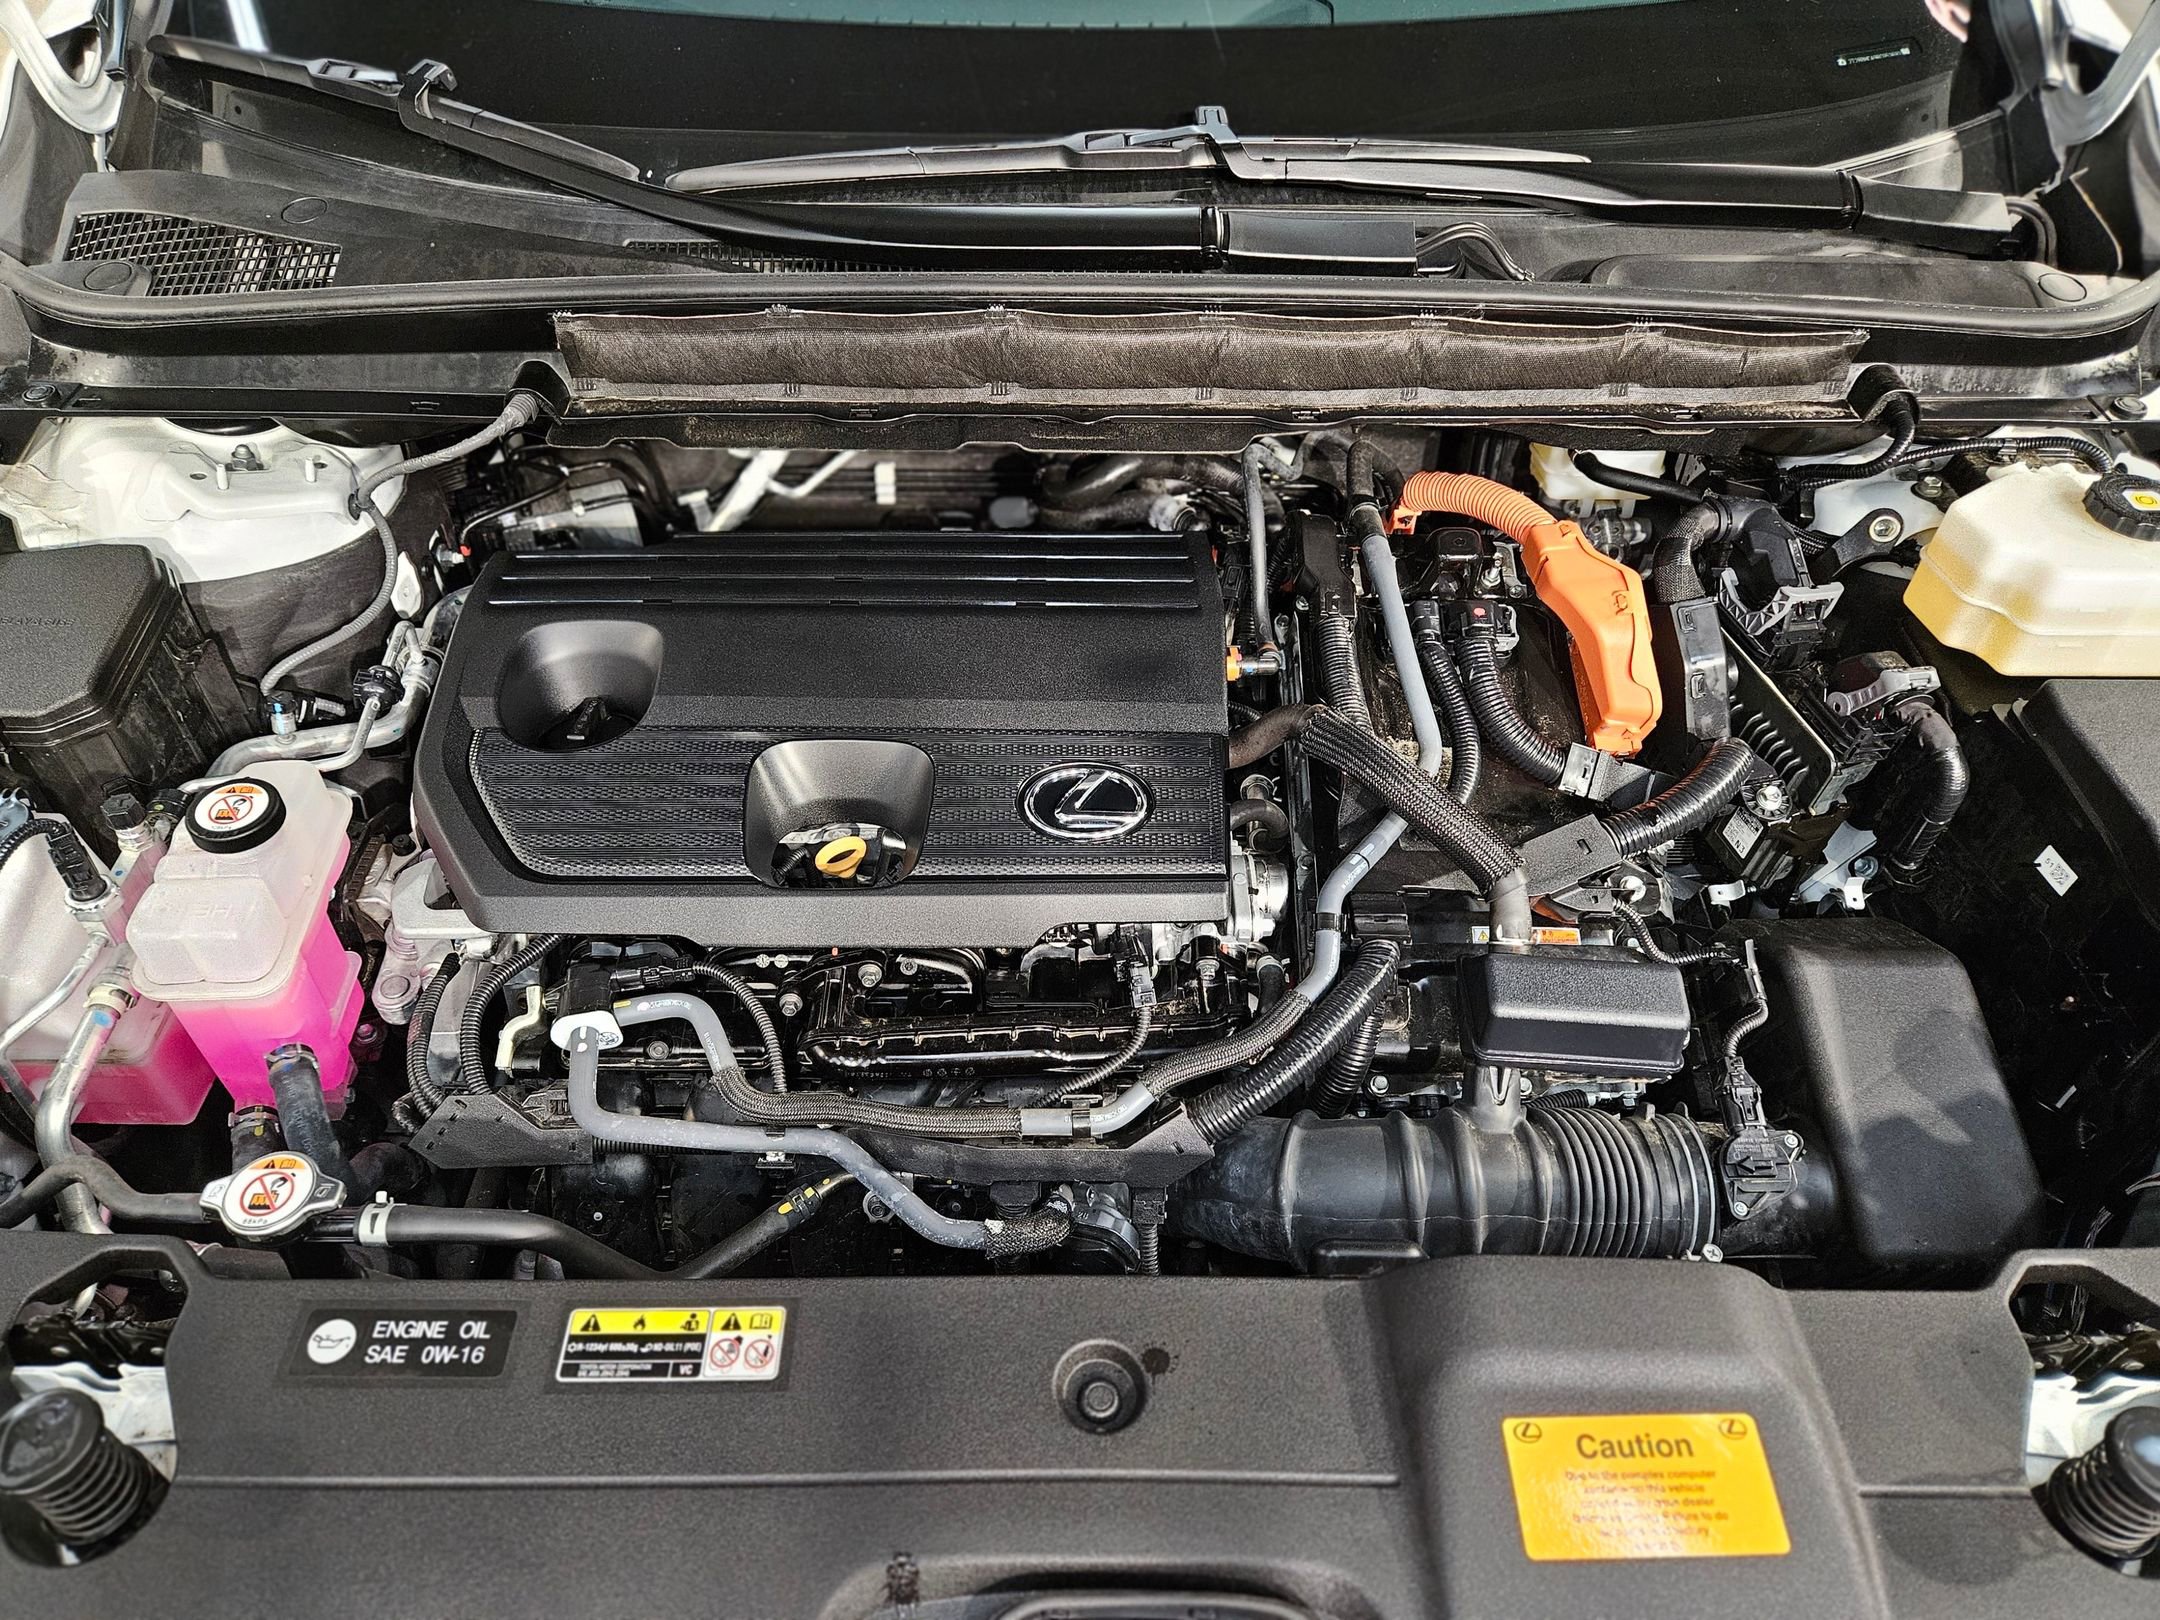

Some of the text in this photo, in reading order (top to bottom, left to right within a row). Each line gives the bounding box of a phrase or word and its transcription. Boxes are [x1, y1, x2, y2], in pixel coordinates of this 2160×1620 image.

[372, 1320, 491, 1339] ENGINE OIL
[364, 1344, 486, 1364] SAE 0W-16
[679, 1364, 694, 1375] VC
[1576, 1433, 1694, 1459] Caution
[1601, 1470, 1618, 1480] the
[1667, 1470, 1716, 1481] computer
[1682, 1497, 1715, 1507] dealer
[1714, 1511, 1728, 1521] do
